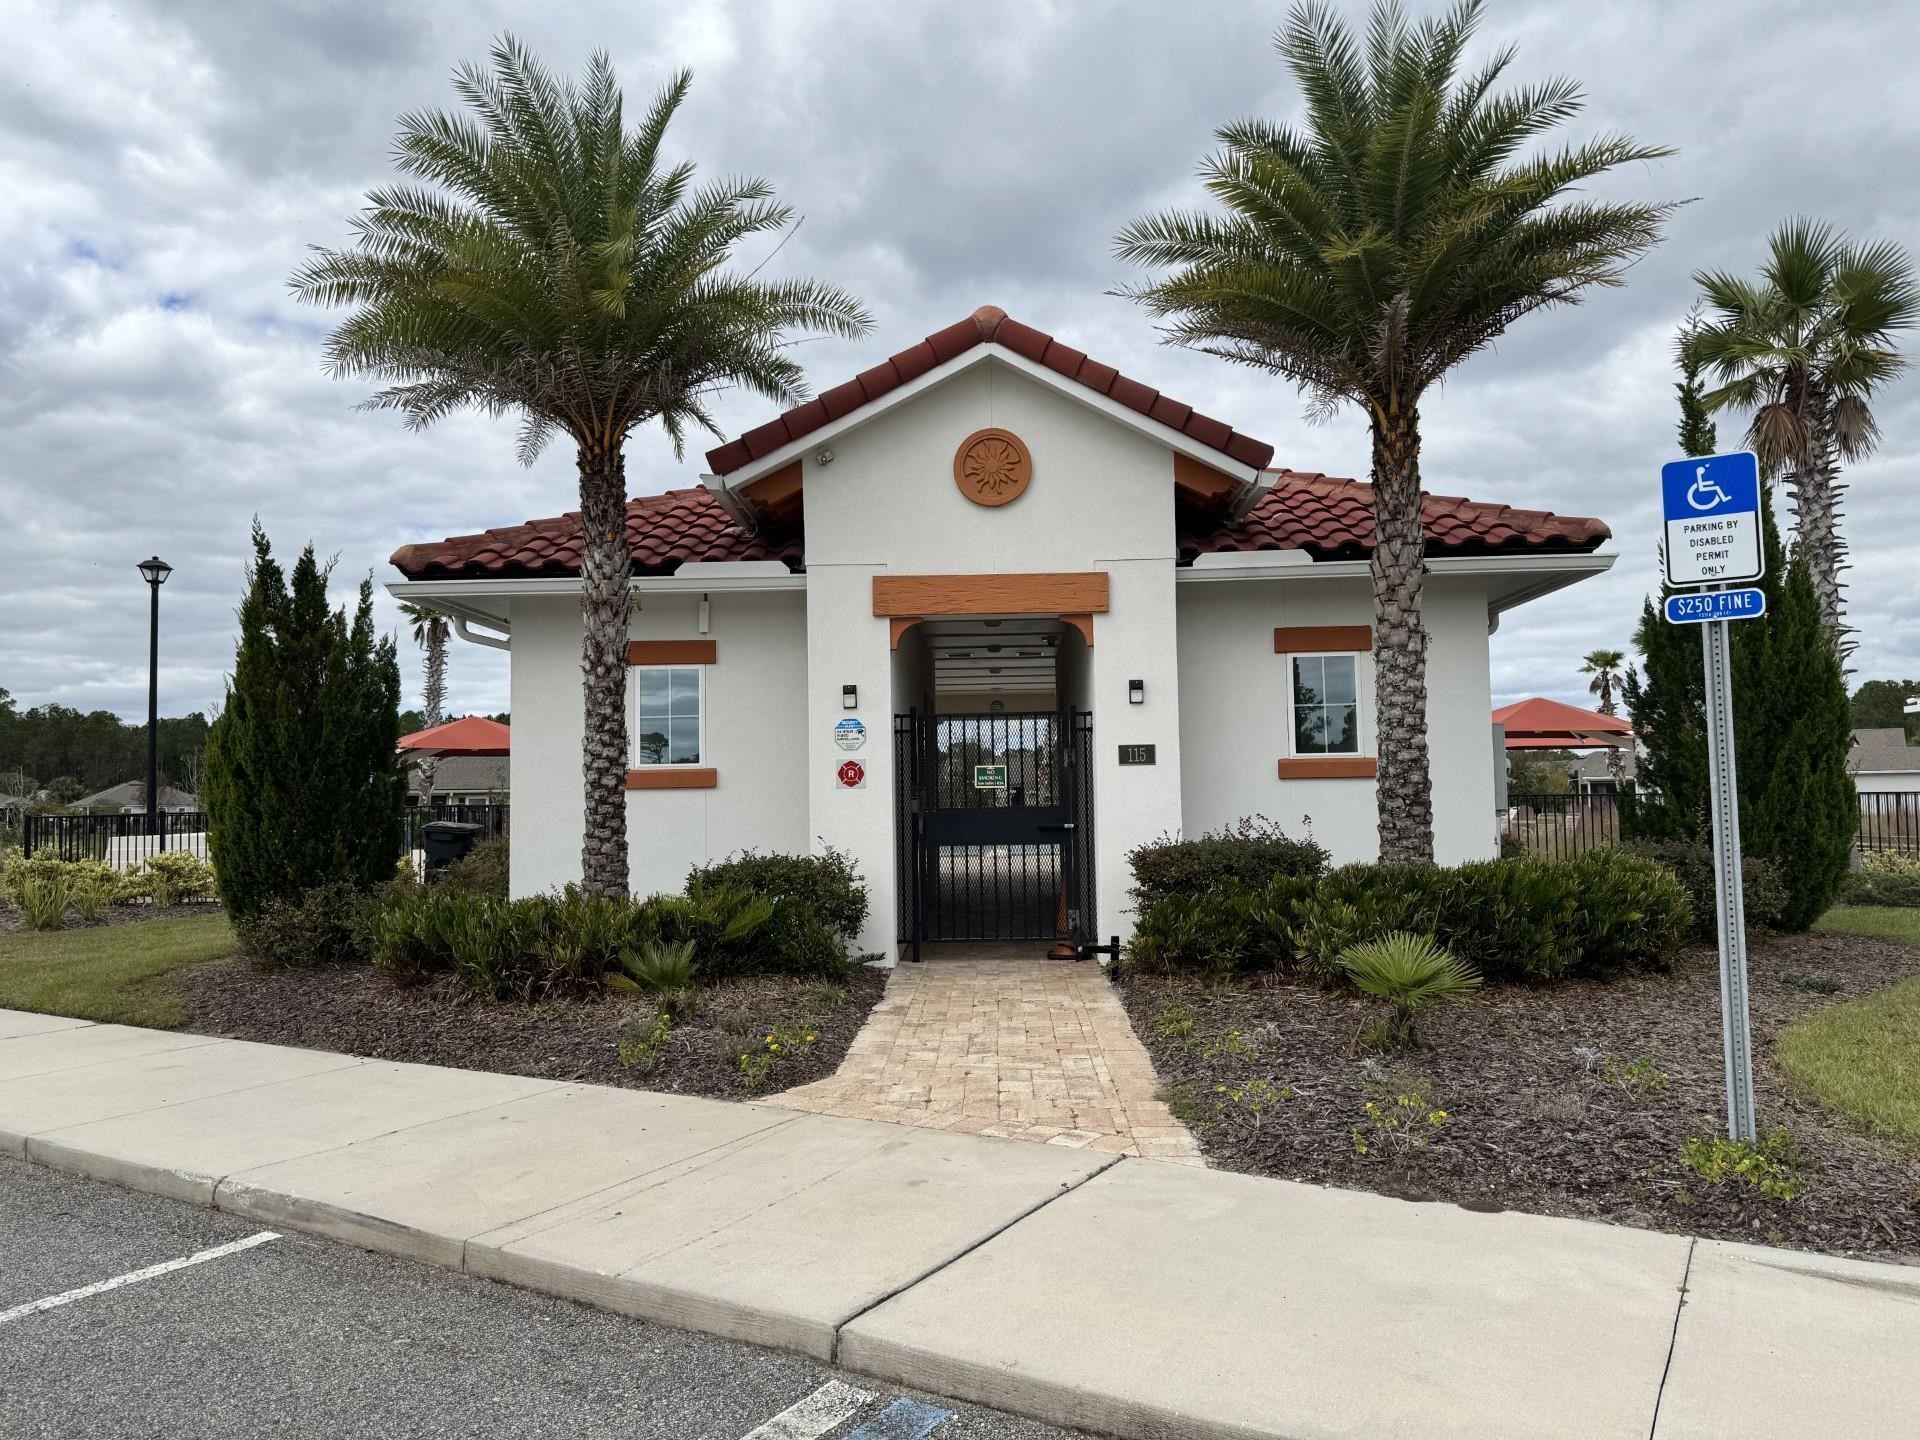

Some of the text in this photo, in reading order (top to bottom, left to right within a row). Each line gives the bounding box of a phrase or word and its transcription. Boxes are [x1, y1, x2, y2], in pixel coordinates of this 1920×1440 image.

[1684, 520, 1738, 534] PARKING BY
[1690, 535, 1734, 548] DISABLED
[1696, 550, 1729, 561] PERMIT
[1702, 565, 1726, 576] ONLY
[1678, 597, 1713, 615] $250
[1719, 593, 1752, 611] FINE
[1127, 747, 1146, 763] 115
[848, 769, 855, 778] R
